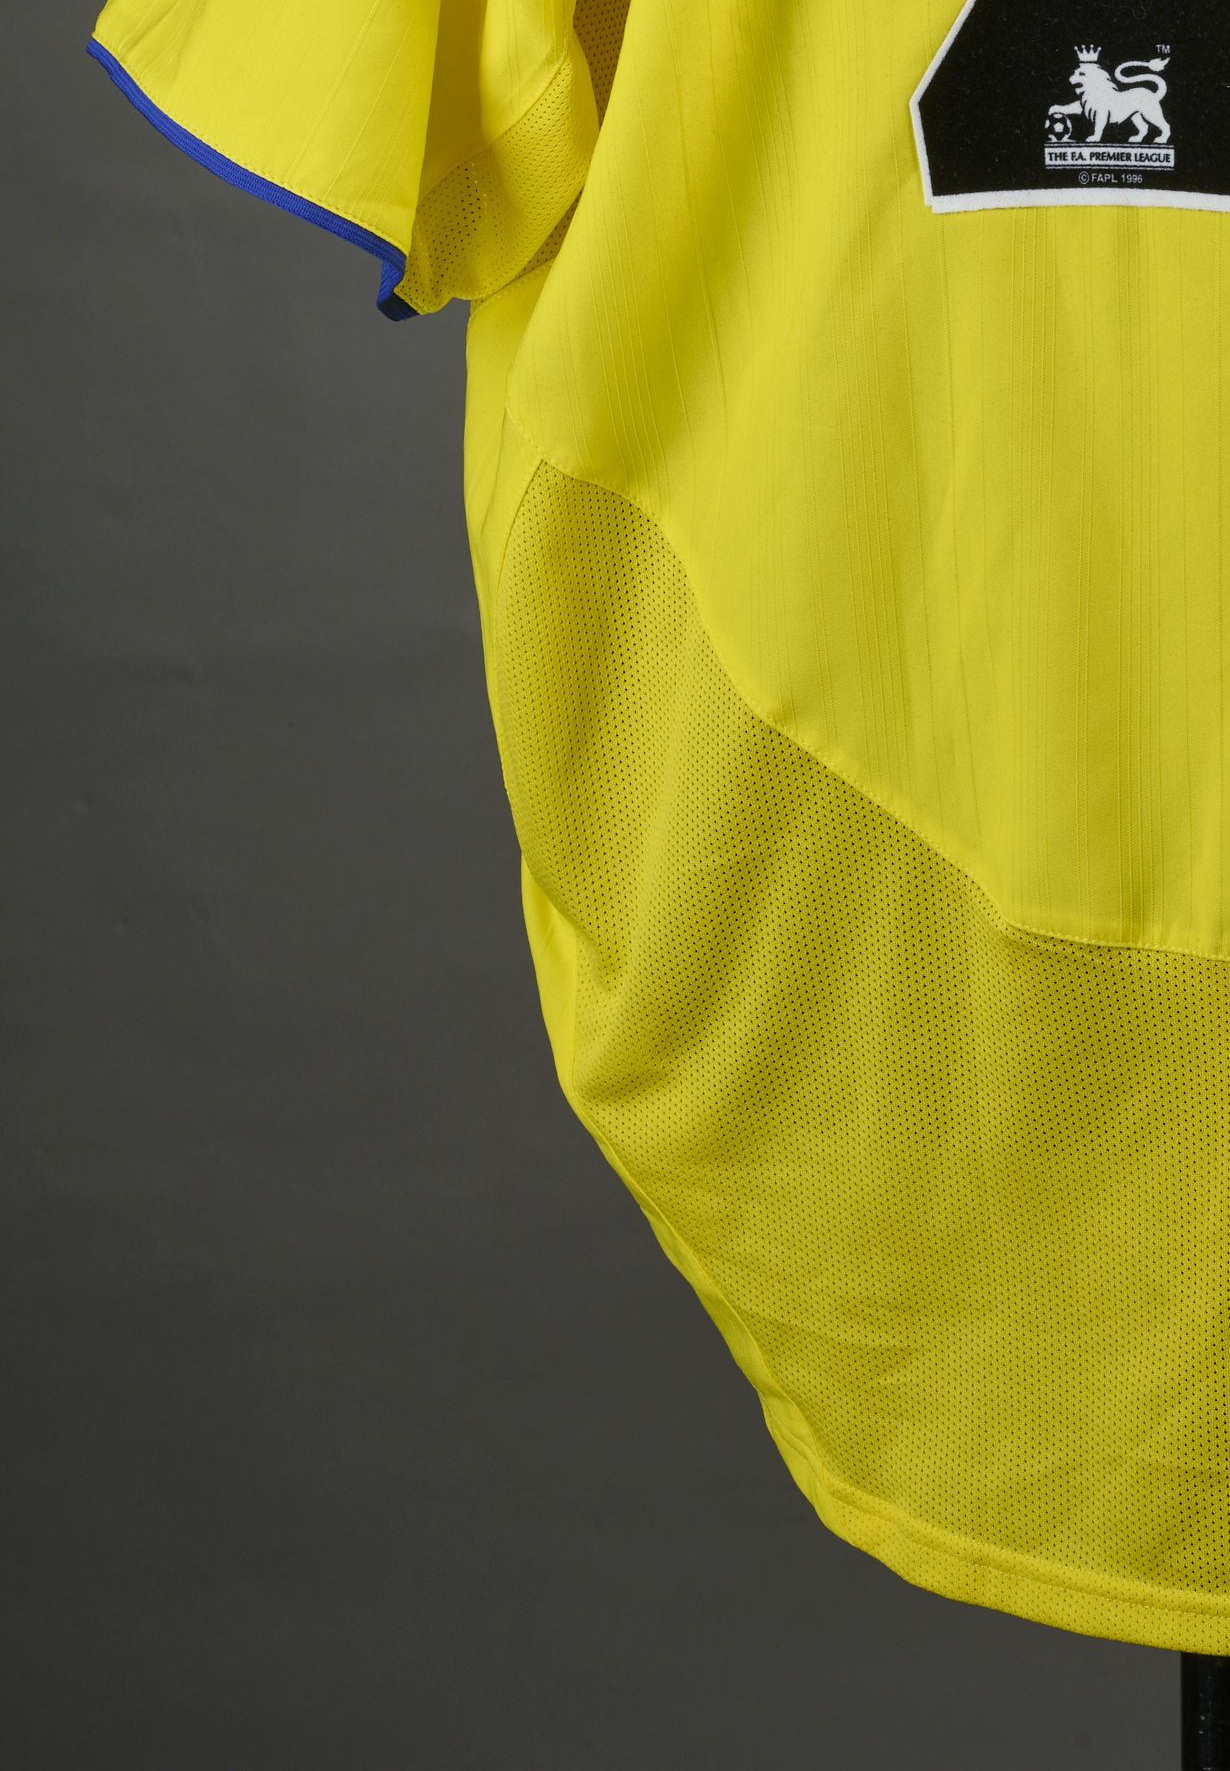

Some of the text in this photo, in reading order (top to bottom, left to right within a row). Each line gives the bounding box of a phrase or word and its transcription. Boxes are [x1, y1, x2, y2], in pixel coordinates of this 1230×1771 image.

[1156, 44, 1171, 54] TM
[1048, 151, 1171, 163] THE F.A. PREMIER LEAGUE
[1121, 173, 1143, 184] 1996
